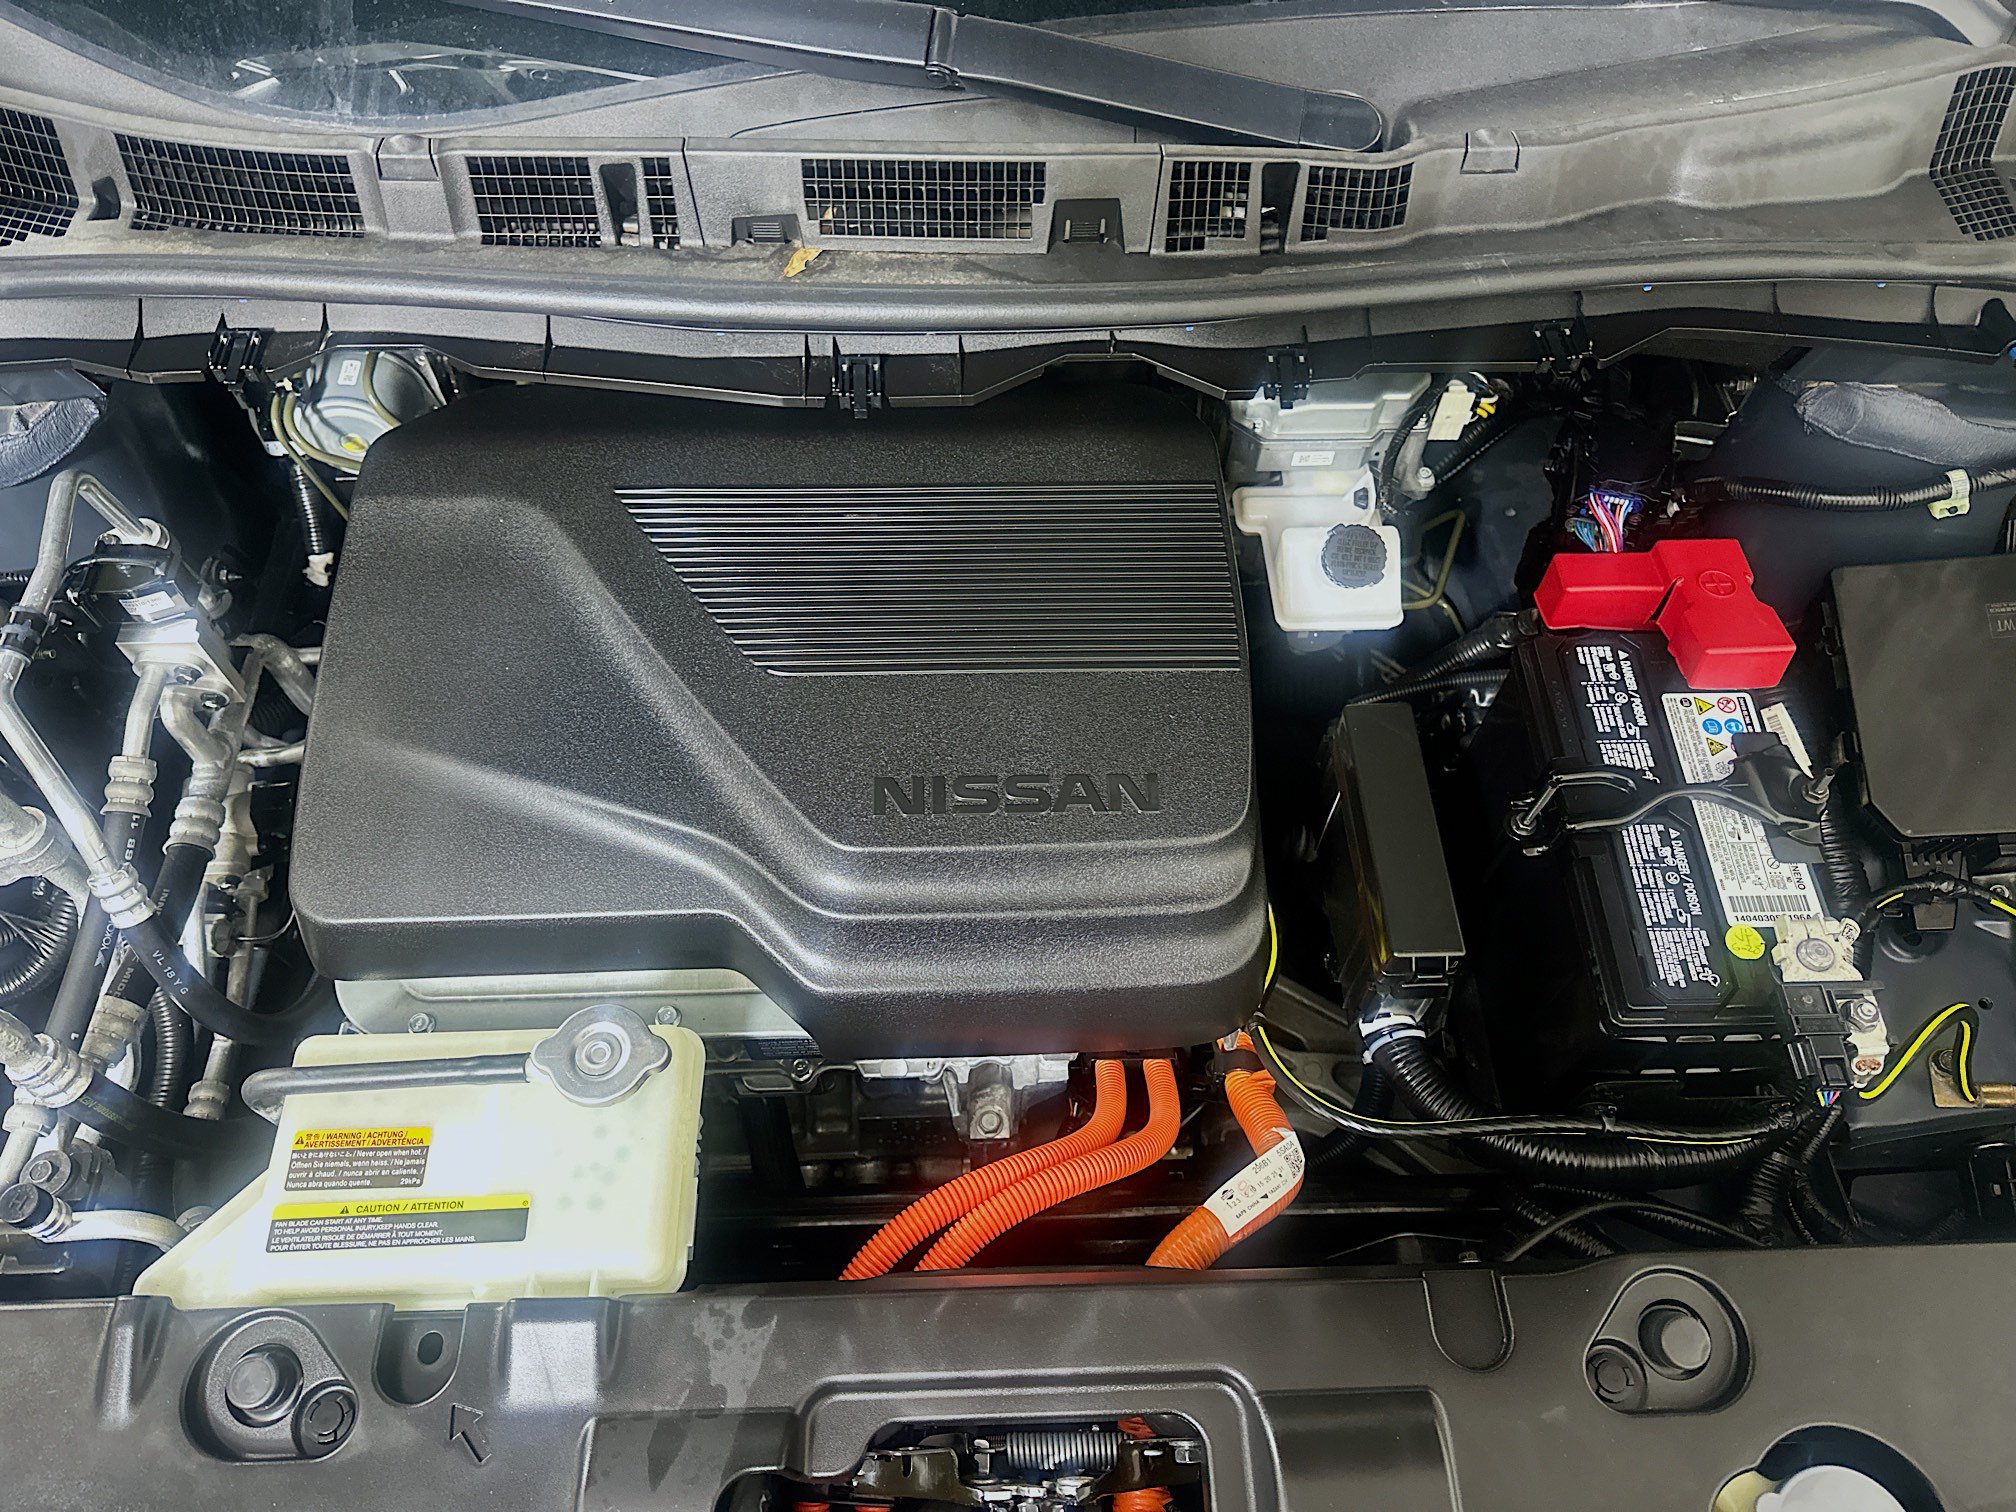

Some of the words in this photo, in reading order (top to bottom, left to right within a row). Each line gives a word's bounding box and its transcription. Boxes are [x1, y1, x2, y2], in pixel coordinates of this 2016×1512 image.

[873, 773, 1161, 816] NISSAN
[100, 920, 118, 950] YOKO
[326, 1132, 362, 1140] WARNING
[367, 1131, 404, 1139] ACHTUNG
[304, 1140, 367, 1148] AVERTISSEMENT
[356, 1150, 376, 1158] Never
[376, 1150, 393, 1158] open
[313, 1160, 324, 1168] Sie
[403, 1157, 425, 1167] jamais
[288, 1171, 308, 1179] ouvrir
[314, 1170, 337, 1178] chaud.
[391, 1167, 419, 1176] caliente.
[287, 1181, 307, 1189] Nunca
[323, 1180, 348, 1189] quando
[356, 1203, 400, 1214] CAUTION
[410, 1200, 465, 1211] ATTENTION
[275, 1220, 288, 1228] FAN
[300, 1226, 321, 1234] AVOID
[320, 1225, 354, 1233] PERSONAL
[393, 1222, 417, 1230] HANDS
[280, 1235, 321, 1243] VENTILATEUR
[322, 1234, 345, 1242] RISQUE
[397, 1230, 415, 1238] TOUT
[270, 1243, 289, 1252] POUR
[290, 1242, 312, 1251] ÉVITER
[312, 1242, 333, 1250] TOUTE
[392, 1238, 402, 1246] EN
[402, 1237, 442, 1245] APPROCHER
[442, 1236, 454, 1244] LES
